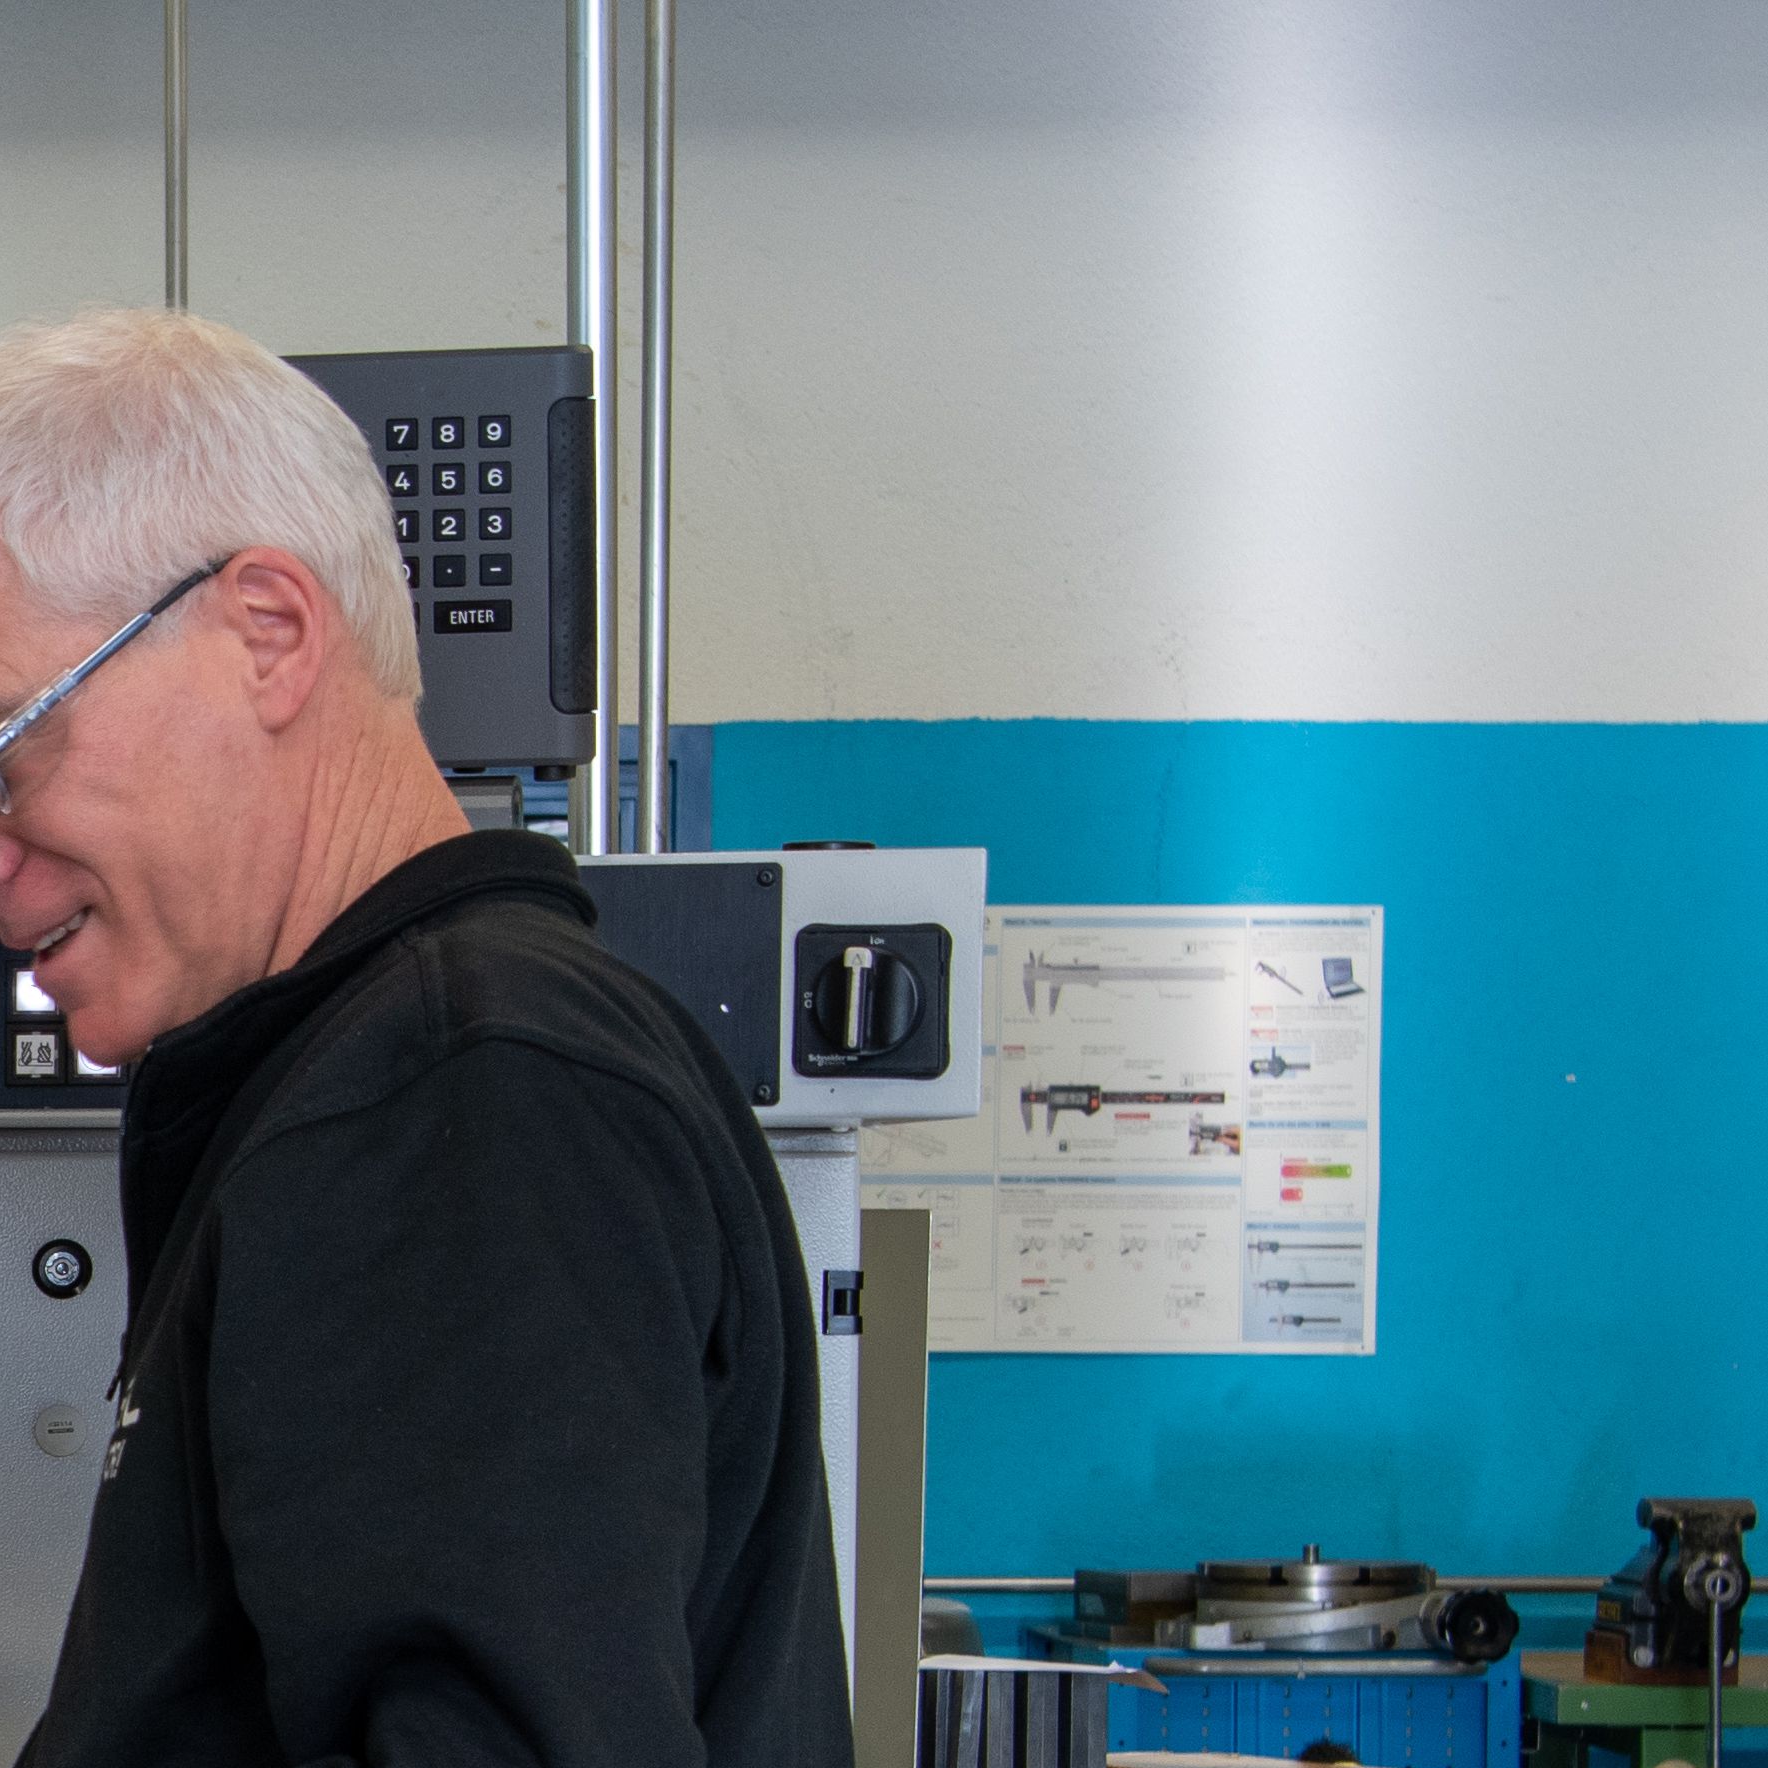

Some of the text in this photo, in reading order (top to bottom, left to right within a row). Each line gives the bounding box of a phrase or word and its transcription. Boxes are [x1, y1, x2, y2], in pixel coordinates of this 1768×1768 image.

[392, 422, 502, 445] 7 8 9
[394, 468, 503, 491] 4 5 6
[397, 514, 503, 537] 1 2 3
[449, 609, 495, 626] ENTER
